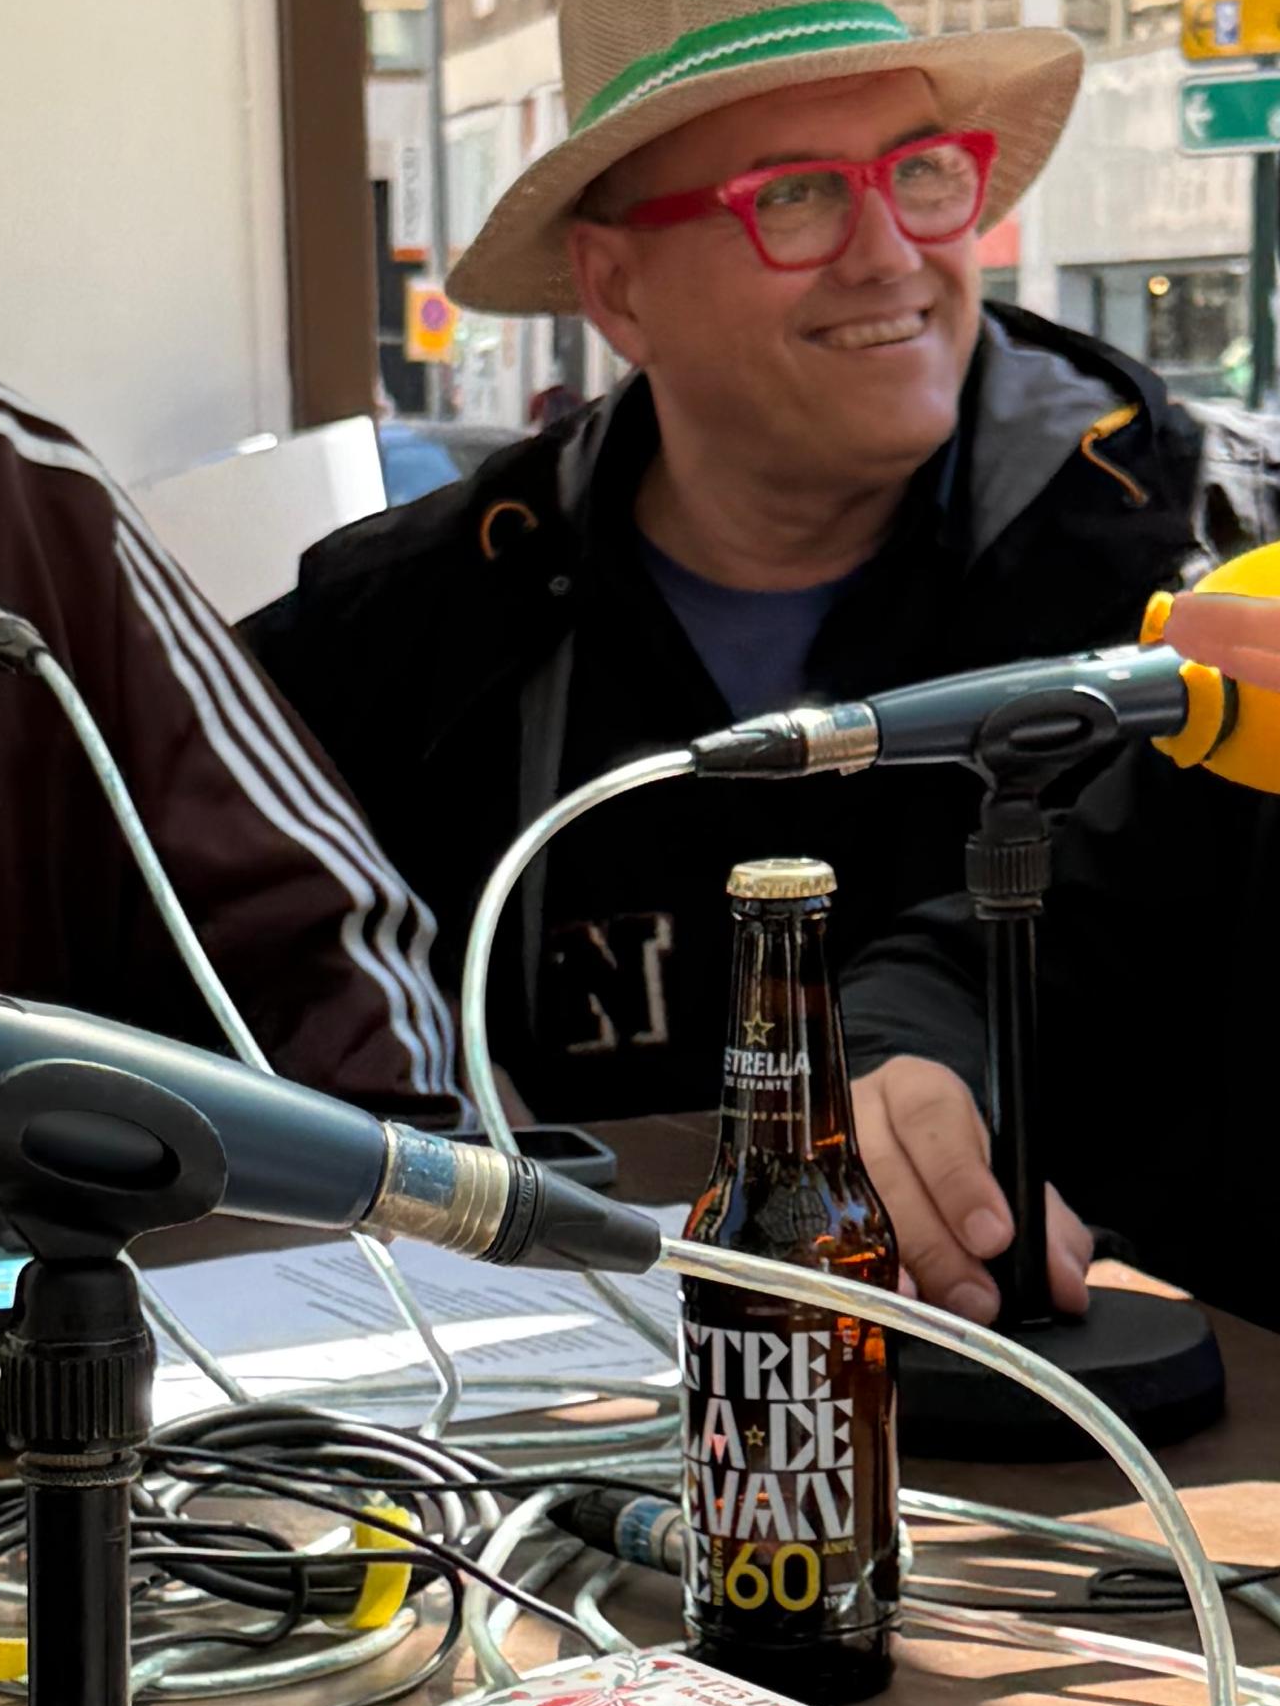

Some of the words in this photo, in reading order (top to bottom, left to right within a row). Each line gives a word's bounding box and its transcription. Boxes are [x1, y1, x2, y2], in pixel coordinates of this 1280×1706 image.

[723, 1046, 812, 1077] STRELLA
[683, 1319, 832, 1401] STRE
[769, 1398, 854, 1472] DE
[725, 1541, 820, 1612] 60
